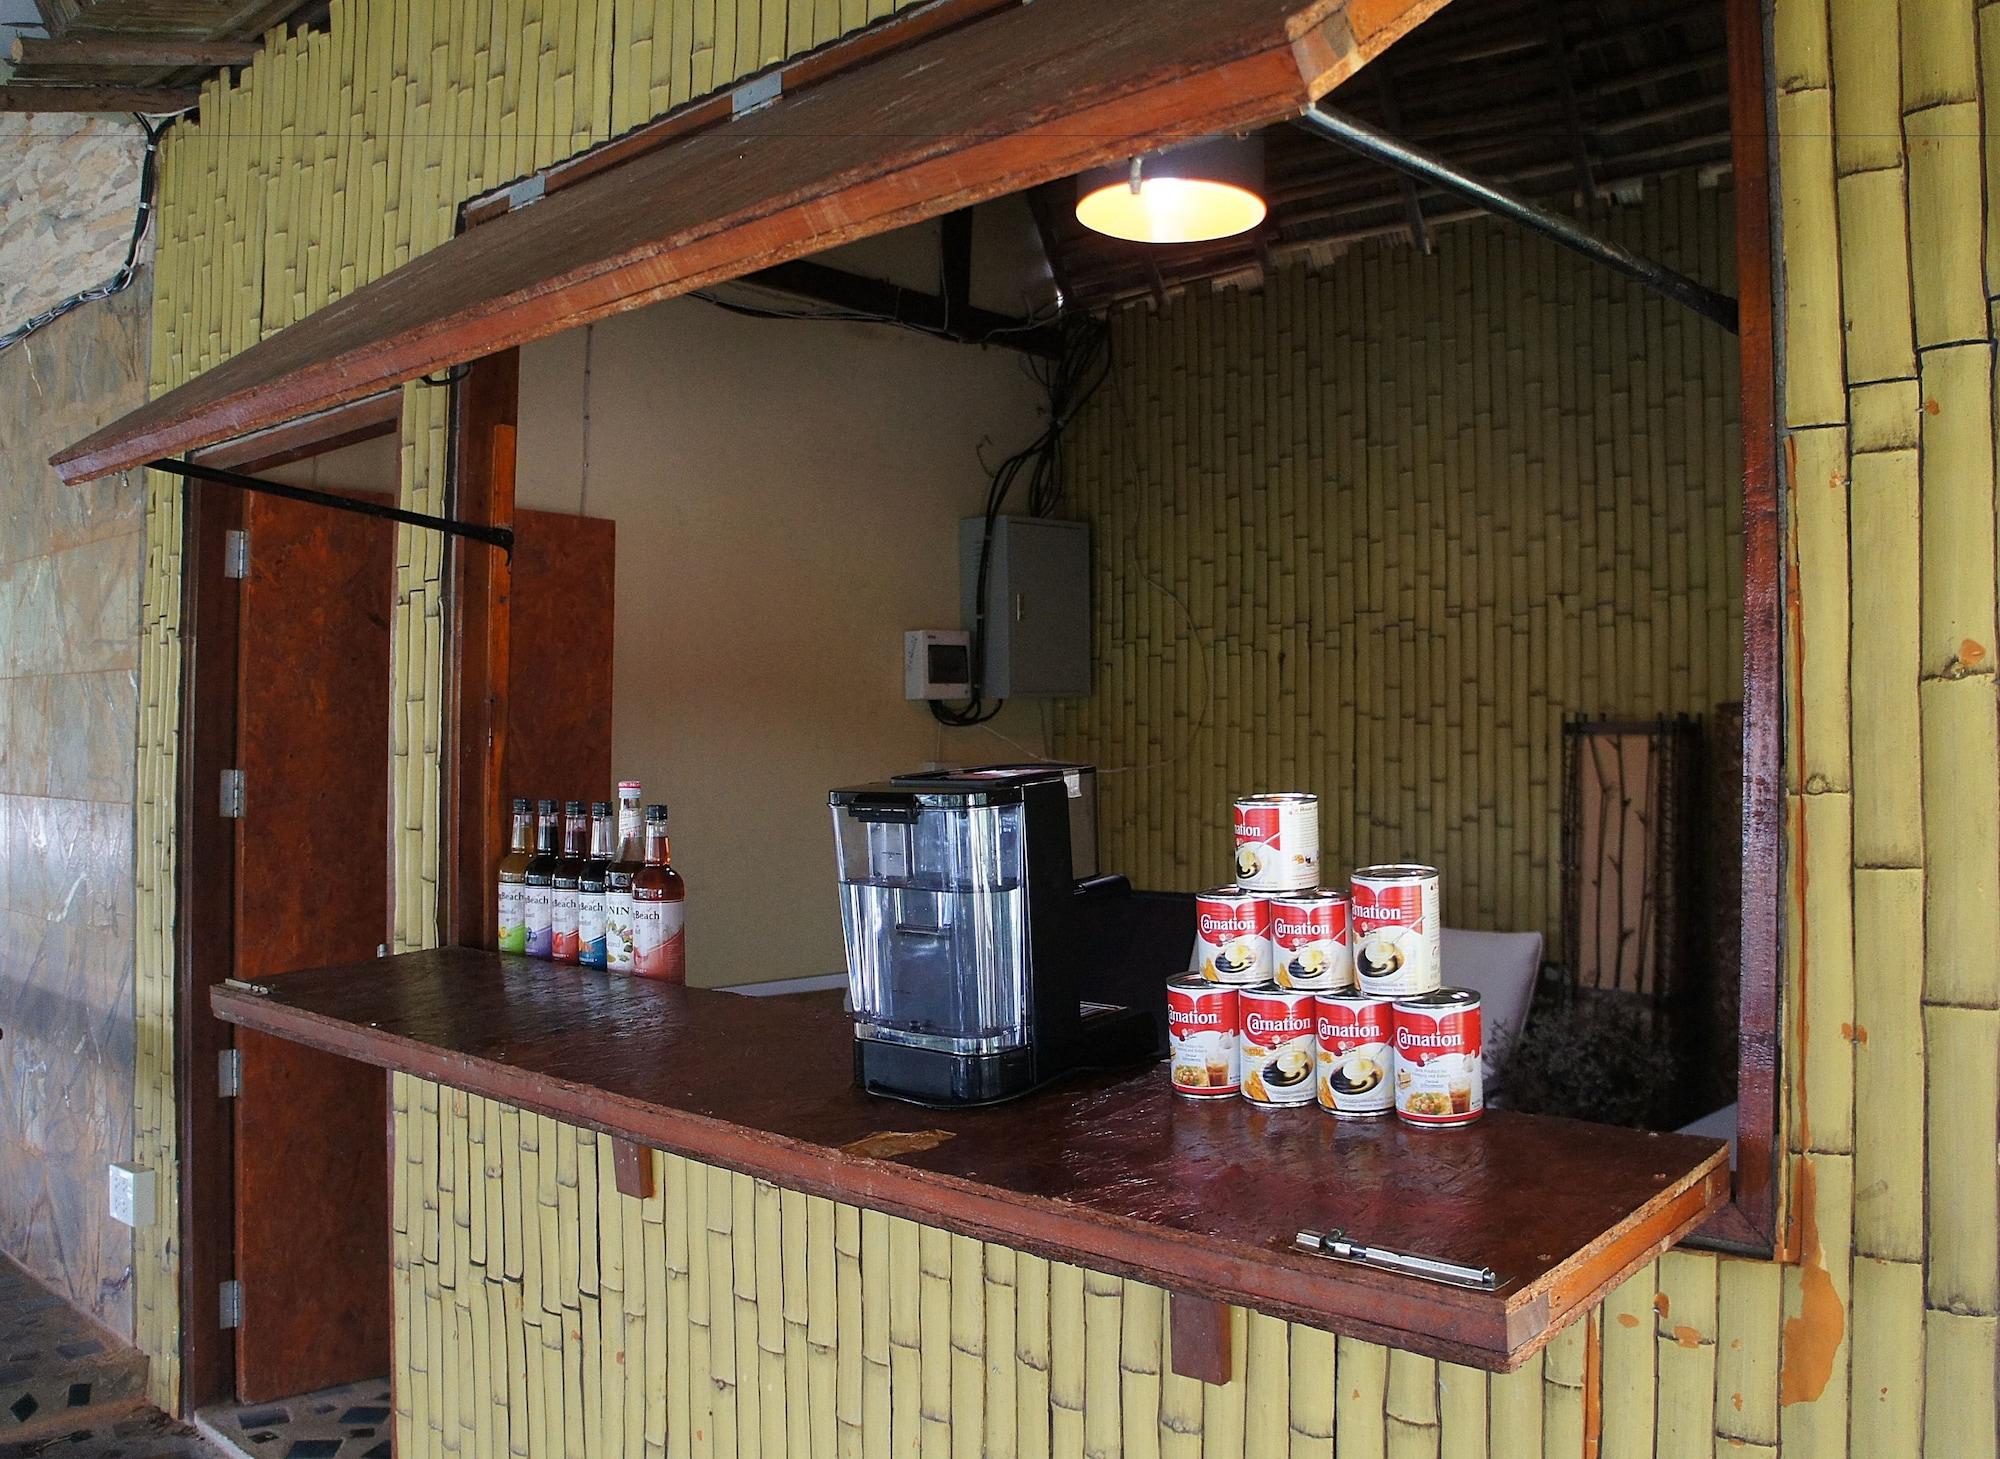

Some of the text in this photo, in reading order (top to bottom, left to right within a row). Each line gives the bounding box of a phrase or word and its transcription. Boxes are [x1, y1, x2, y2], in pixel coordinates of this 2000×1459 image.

[525, 895, 549, 904] Beach
[553, 899, 577, 909] Beach
[1200, 914, 1256, 934] Carnation
[1274, 918, 1330, 938] Carnation
[1246, 1013, 1311, 1035] Carnation
[1317, 1017, 1381, 1040] Carnation
[1397, 1026, 1462, 1050] Carnation
